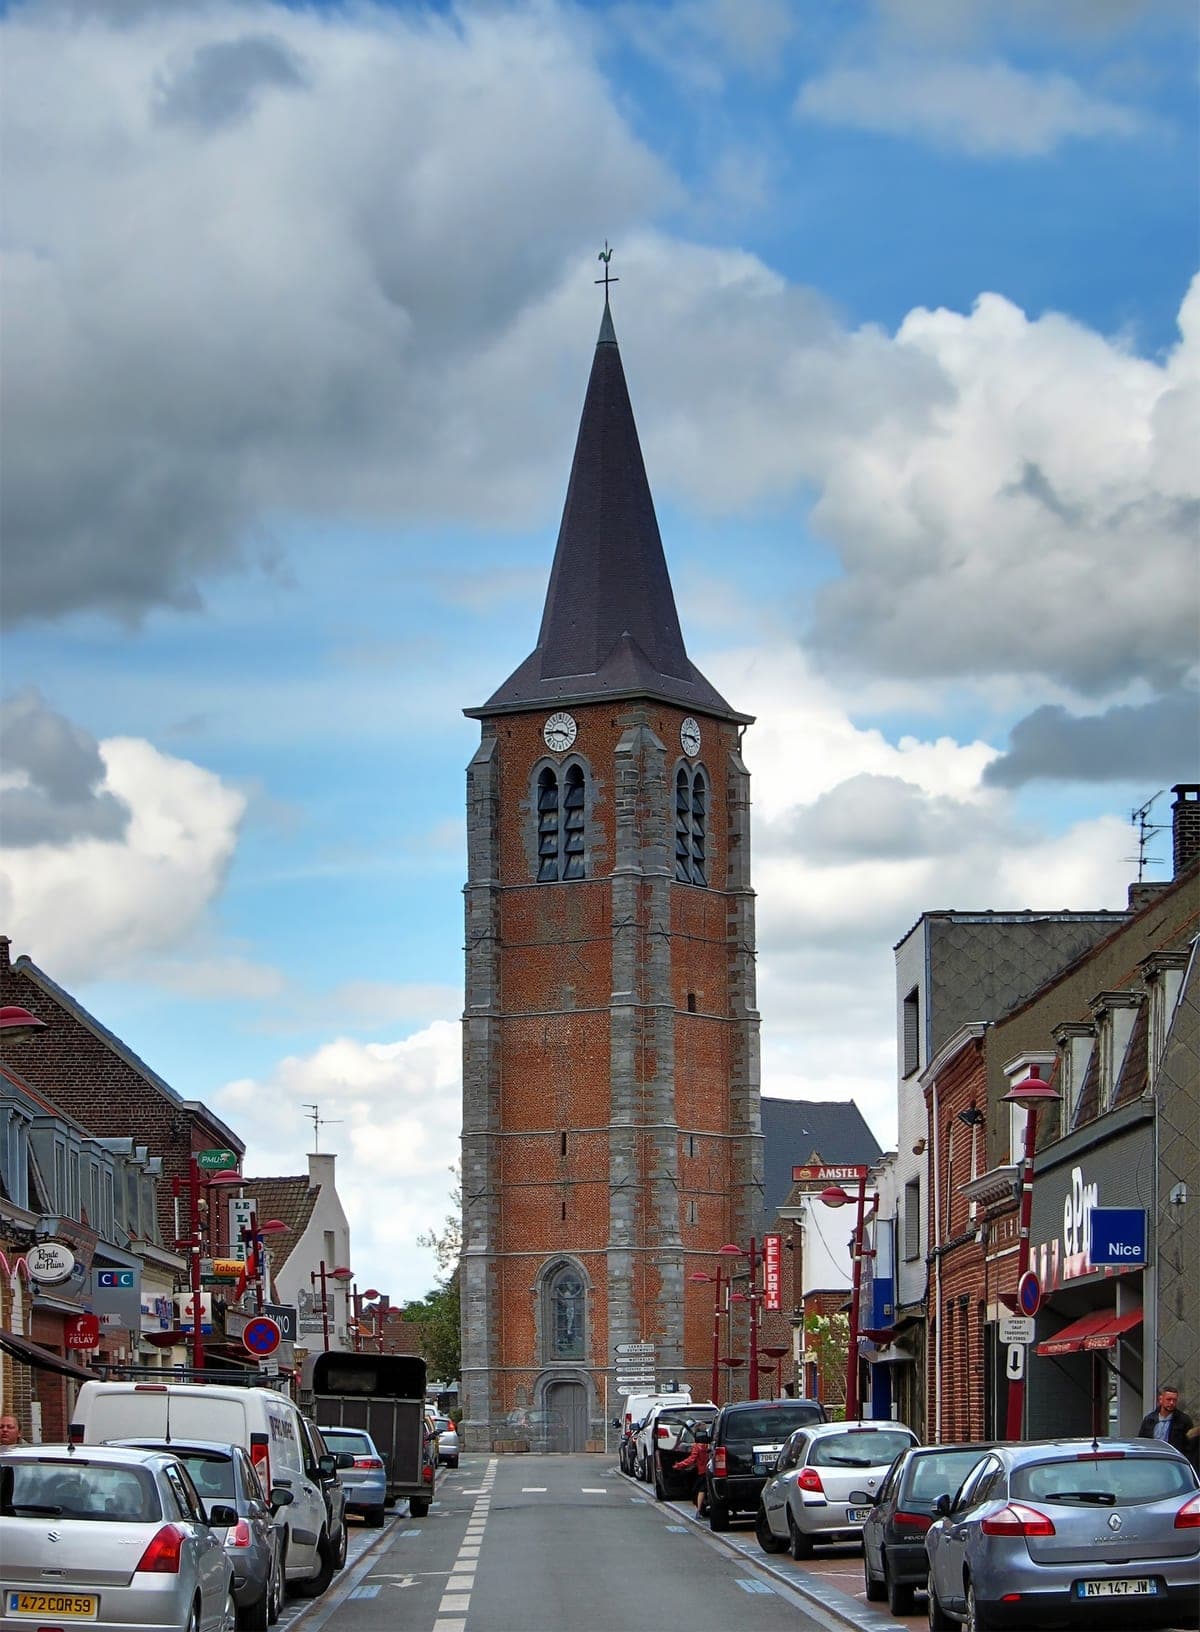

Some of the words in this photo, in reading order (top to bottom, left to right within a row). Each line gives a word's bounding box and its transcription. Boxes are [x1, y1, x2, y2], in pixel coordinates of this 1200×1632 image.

[201, 1156, 220, 1164] PMU
[818, 1167, 860, 1179] AMSTEL
[1108, 1242, 1142, 1256] Nice
[215, 1263, 242, 1273] Tabac
[767, 1237, 778, 1309] PELFORTH
[101, 1273, 131, 1285] CIC
